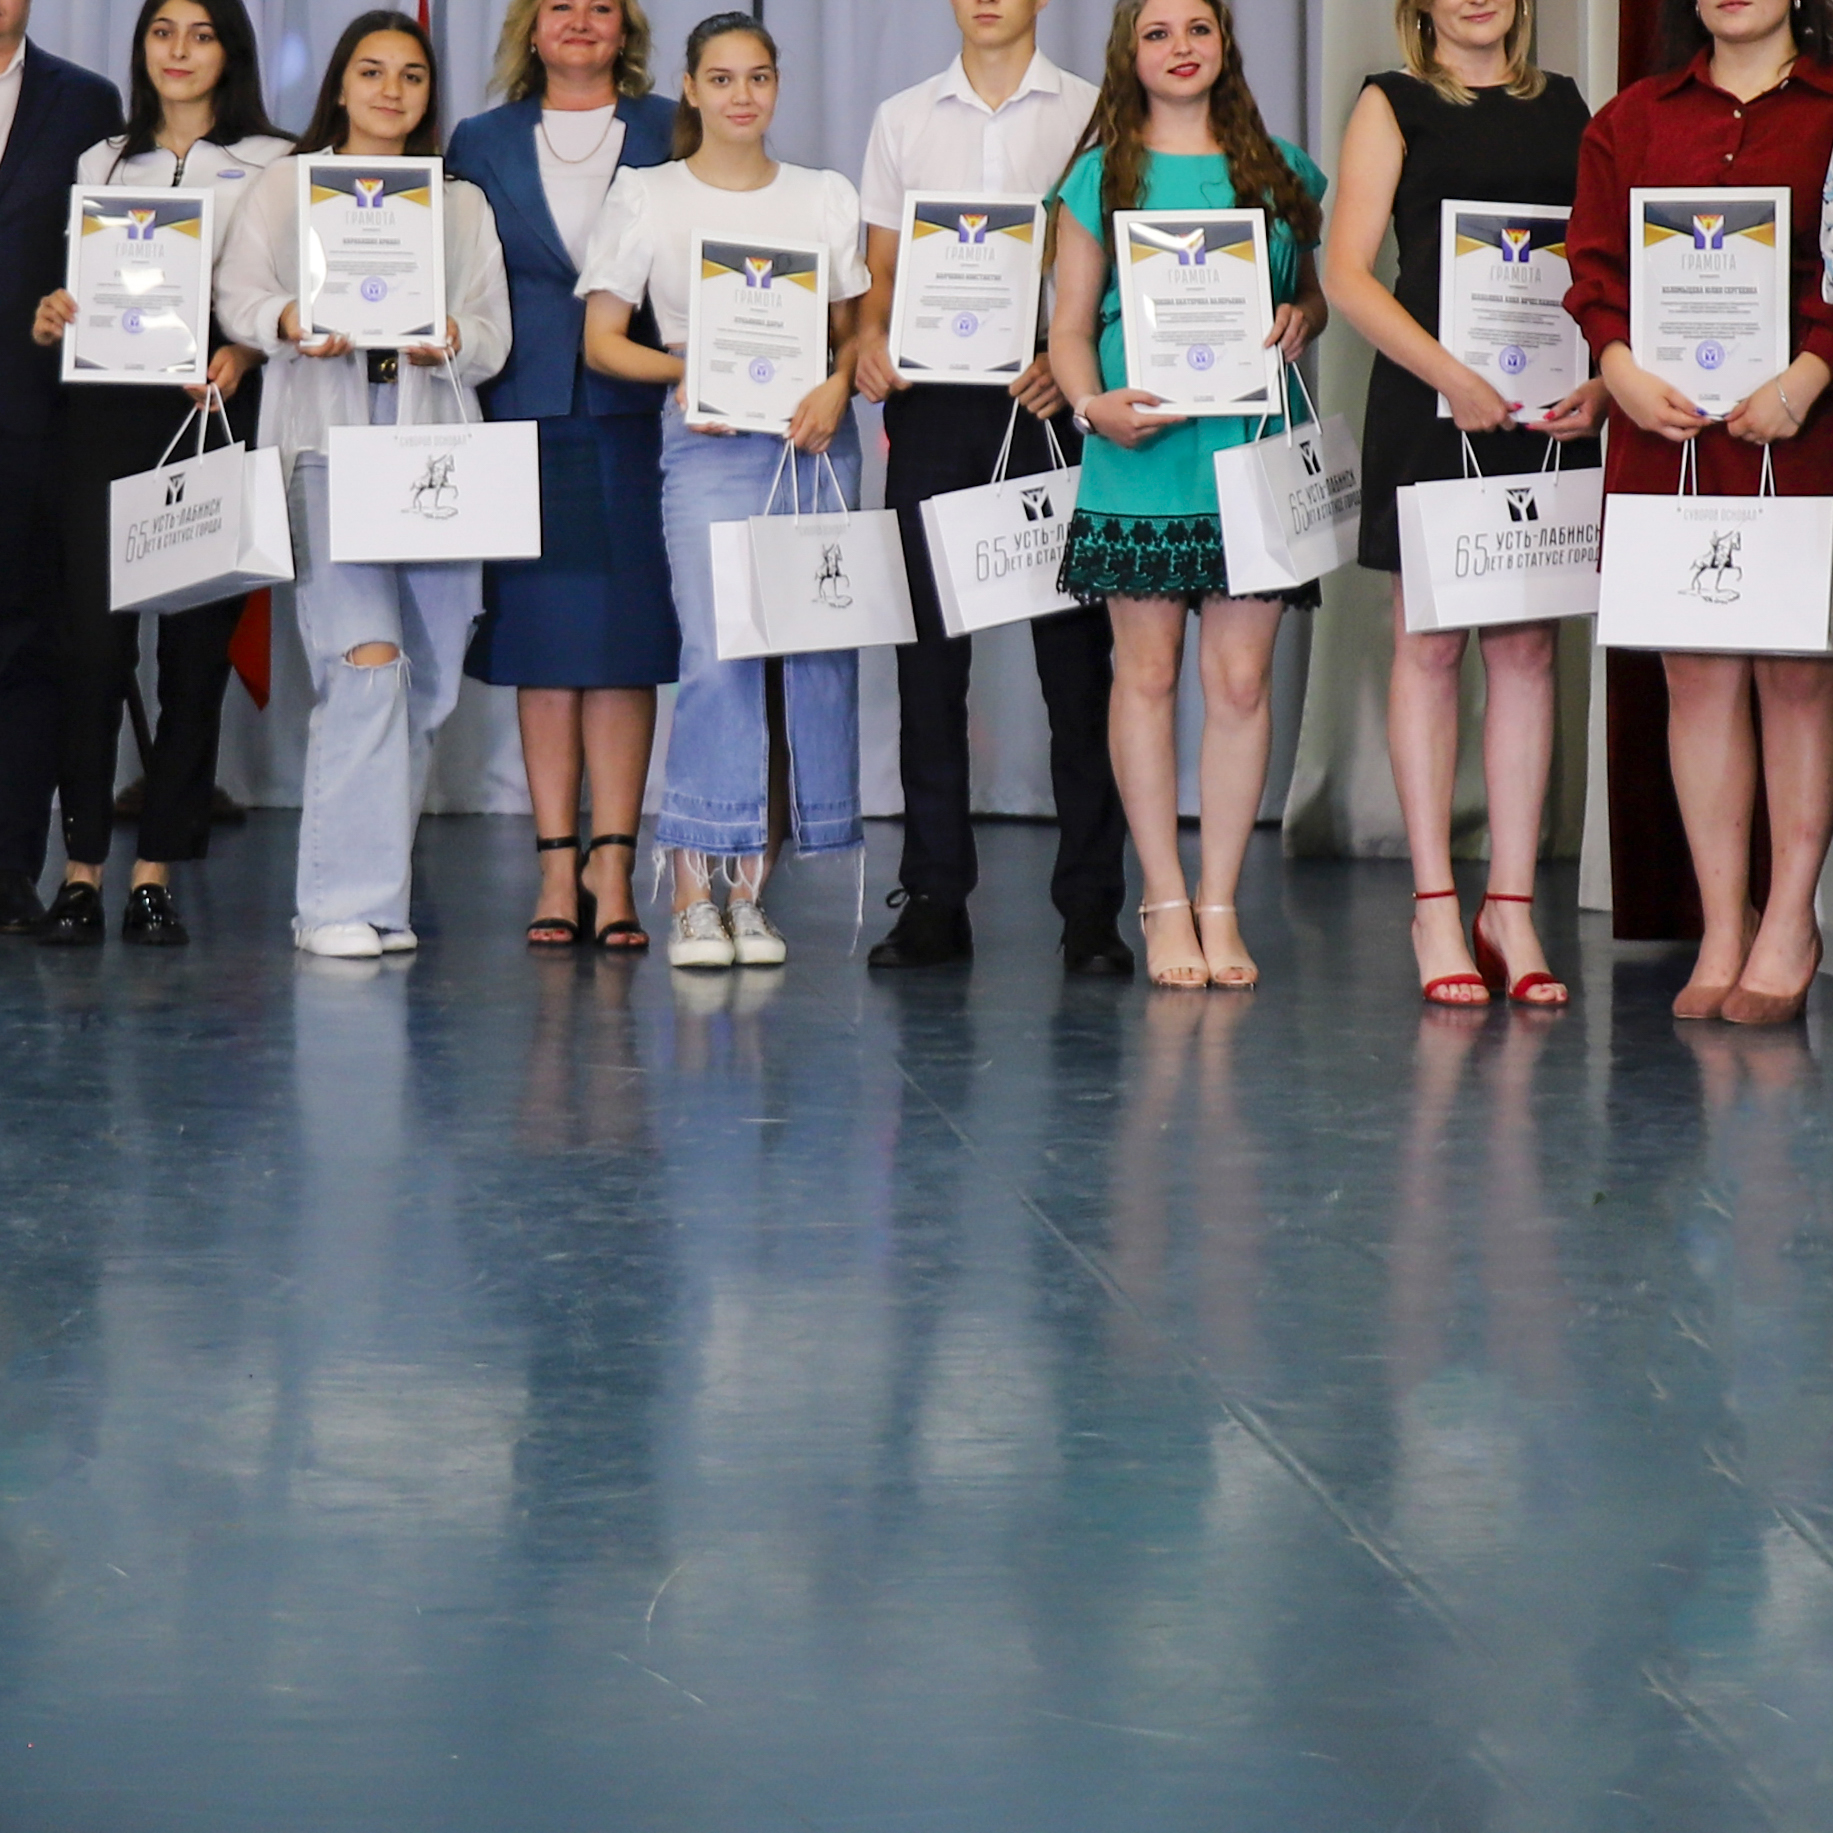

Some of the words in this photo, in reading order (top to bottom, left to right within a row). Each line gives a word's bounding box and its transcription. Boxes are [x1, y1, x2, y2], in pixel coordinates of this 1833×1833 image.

[1681, 253, 1737, 271] ГРАМОТА
[976, 536, 1006, 581] 65
[1027, 553, 1032, 567] В
[1036, 546, 1063, 565] СТАТ
[1455, 533, 1488, 578] 65
[1507, 554, 1513, 569] В
[1518, 549, 1563, 569] СТАТУСЕ
[1569, 546, 1600, 564] ГОРОД
